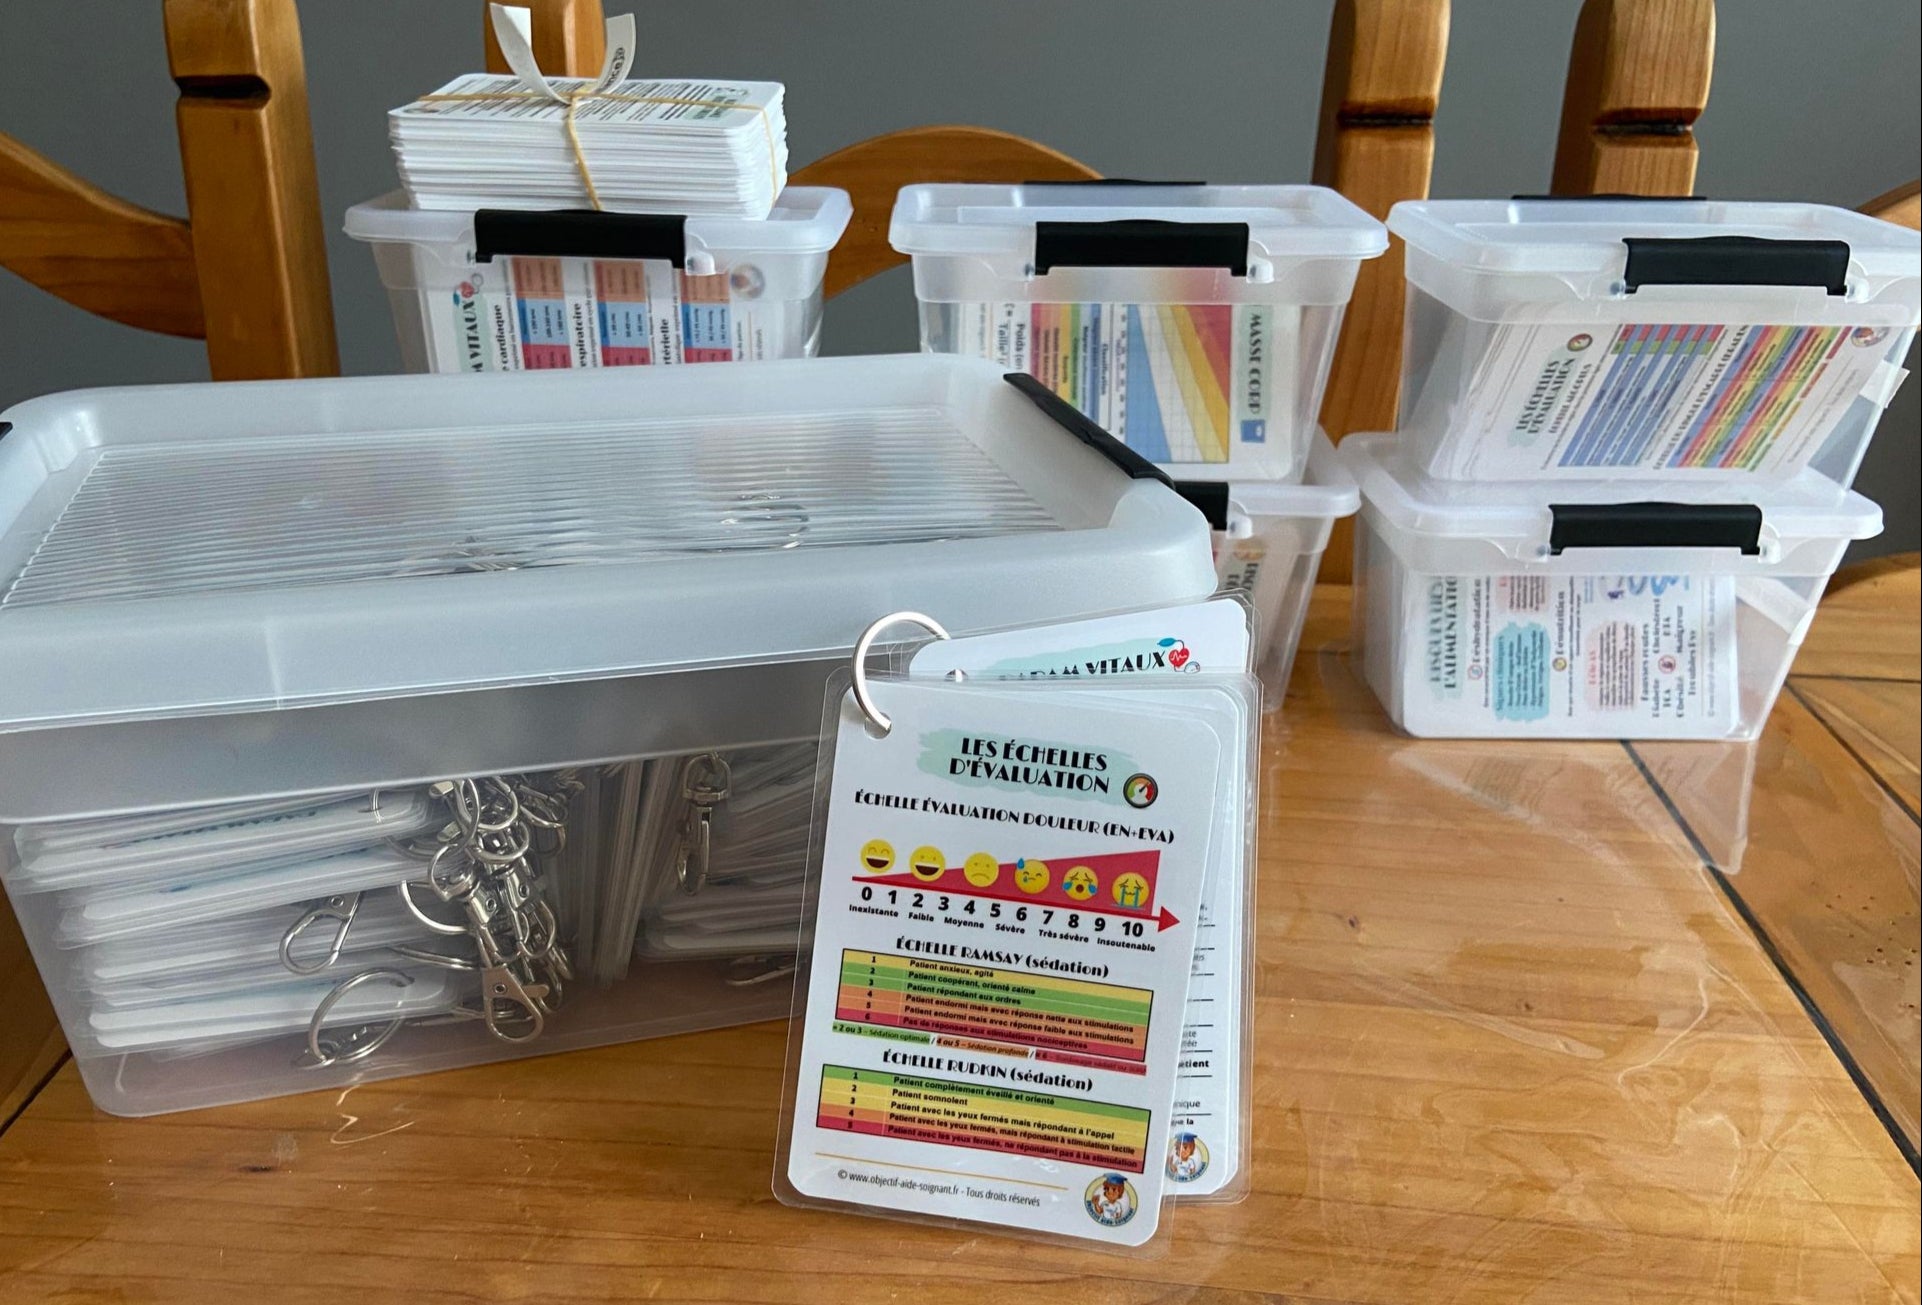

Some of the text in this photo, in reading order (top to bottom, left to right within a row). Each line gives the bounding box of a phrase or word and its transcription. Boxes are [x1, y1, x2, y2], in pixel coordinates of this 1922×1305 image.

[462, 300, 481, 360] VITAUX
[493, 304, 509, 364] cardiaque
[1249, 312, 1262, 363] MASSE
[1085, 650, 1165, 675] VITAUX
[961, 737, 1107, 771] LES ÉCHELLES
[949, 757, 1110, 794] D'ÉVALUATION
[855, 790, 1174, 844] ÉCHELLE ÉVALUATION DOULEUR (EN+EVA)
[849, 904, 1156, 952] Inexistante Faible Moyenne Sévère Très sévère Insoutenable
[861, 886, 1143, 937] 0 1 2 3 4 5 6 7 8 9 10
[896, 936, 1109, 978] ÉCHELLE RAMSAY (sédation)
[909, 959, 938, 970] Patient
[939, 965, 973, 976] anxieux,
[974, 968, 994, 979] agité
[907, 983, 935, 993] Patient
[936, 987, 977, 1001] répondant
[979, 993, 993, 1001] aux
[994, 995, 1021, 1005] ordres
[908, 971, 936, 981] Patient
[938, 976, 981, 988] coopérant,
[982, 981, 1010, 992] orienté
[904, 1005, 932, 1017] Patient
[933, 1010, 967, 1022] endormi
[968, 1016, 987, 1024] mais
[989, 1018, 1008, 1027] avec
[1010, 1020, 1042, 1033] réponse
[1044, 1024, 1066, 1035] faible
[1068, 1029, 1082, 1037] aux
[1085, 1030, 1134, 1045] stimulations
[905, 994, 933, 1005] Patient
[934, 999, 968, 1010] endormi
[970, 1004, 988, 1012] mais
[991, 1006, 1010, 1015] avec
[1011, 1008, 1043, 1021] réponse
[1068, 1017, 1082, 1025] aux
[1085, 1018, 1134, 1033] stimulations
[931, 1020, 968, 1034] réponses
[883, 1049, 1093, 1092] ÉCHELLE RUDKIN (sédation)
[892, 1089, 922, 1100] Patient
[923, 1094, 968, 1105] somnolent
[894, 1076, 923, 1087] Patient
[924, 1081, 984, 1096] complètement
[985, 1088, 1013, 1100] éveillé
[1025, 1095, 1055, 1105] orienté
[889, 1113, 916, 1124] Patient
[917, 1118, 936, 1127] avec
[937, 1119, 948, 1128] les
[950, 1122, 968, 1132] yeux
[970, 1124, 998, 1134] fermés,
[999, 1129, 1018, 1137] mais
[1019, 1131, 1058, 1144] répondant
[1067, 1137, 1110, 1151] stimulation
[1111, 1144, 1135, 1155] tactile
[890, 1101, 920, 1113] Patient
[921, 1106, 941, 1115] avec
[943, 1108, 955, 1117] les
[958, 1111, 978, 1122] yeux
[980, 1113, 1009, 1124] fermés
[1011, 1118, 1031, 1127] mais
[1033, 1121, 1077, 1135] répondant
[1085, 1127, 1115, 1140] l'appel
[888, 1125, 916, 1136] Patient
[917, 1130, 937, 1139] avec
[938, 1131, 949, 1140] les
[952, 1134, 971, 1145] yeux
[1016, 1143, 1058, 1156] répondant
[1059, 1150, 1074, 1160] pas
[1092, 1154, 1137, 1168] stimulation
[849, 1172, 959, 1195] www.objectif-aide-soignant.fr
[966, 1186, 984, 1199] Tous
[985, 1189, 1008, 1202] droits
[1008, 1192, 1041, 1207] réservés
